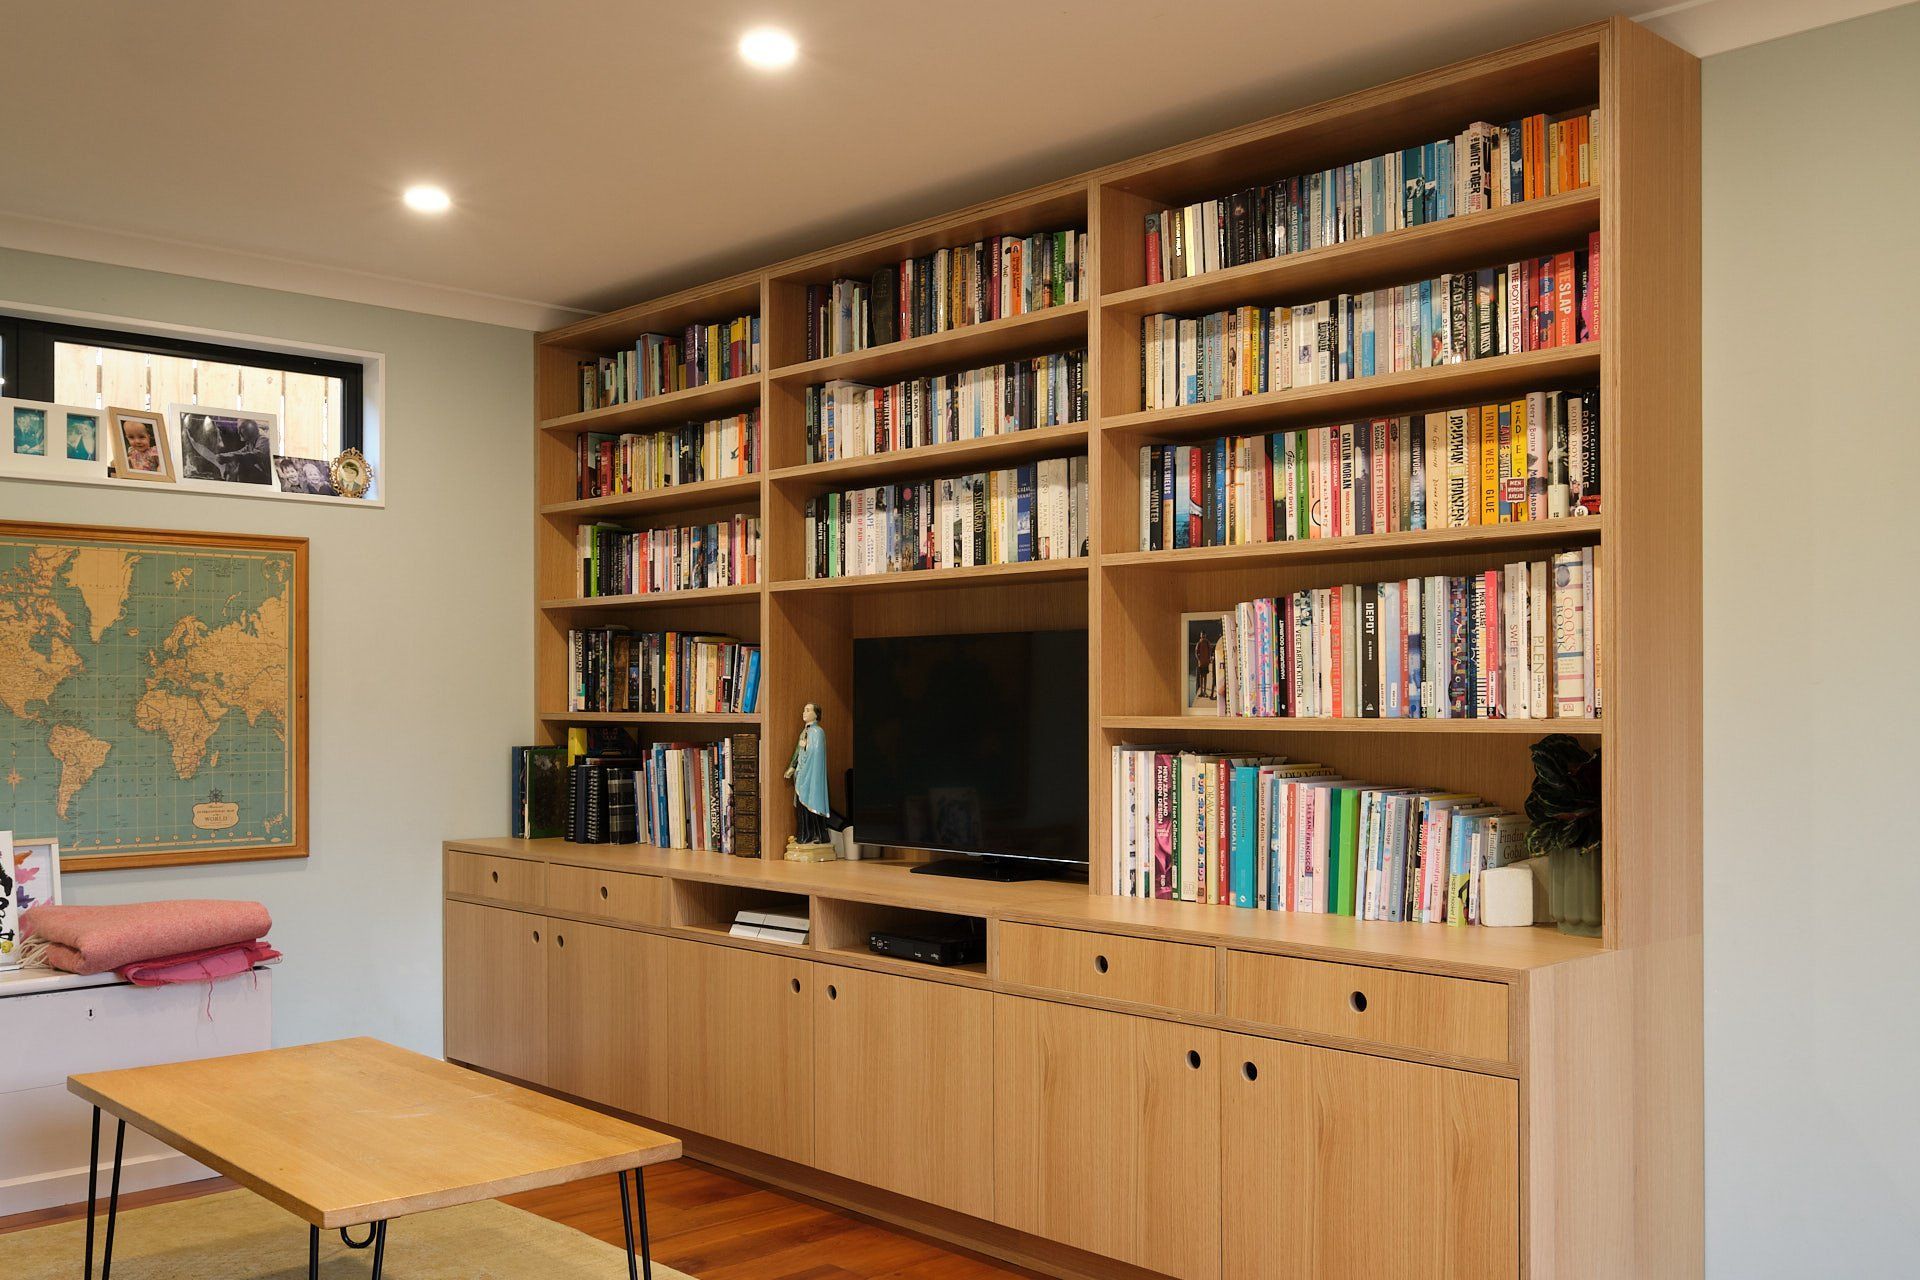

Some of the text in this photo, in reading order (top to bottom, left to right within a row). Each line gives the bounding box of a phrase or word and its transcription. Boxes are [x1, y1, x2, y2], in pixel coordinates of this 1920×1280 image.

[1470, 142, 1481, 194] WHITE TIGER
[1511, 268, 1520, 353] THE BOYS IN THE BOAT
[1559, 282, 1572, 315] SLAP
[1342, 432, 1352, 461] CAITLIN
[1485, 411, 1495, 513] IRVINE WELSH GLUE
[1342, 462, 1352, 490] MORAN
[1375, 453, 1385, 518] THEFT FINDING
[1450, 415, 1464, 521] JONATHAN FRANZEN
[973, 491, 983, 533] STALINGRAD
[1150, 490, 1159, 523] WINTER
[1365, 602, 1374, 635] DEPOT
[1555, 605, 1566, 649] BOOK
[1562, 596, 1576, 652] COOK'S
[1509, 624, 1518, 659] SWEET
[1206, 785, 1214, 816] DRAW
[1220, 783, 1226, 791] TO
[1489, 833, 1497, 861] Finding
